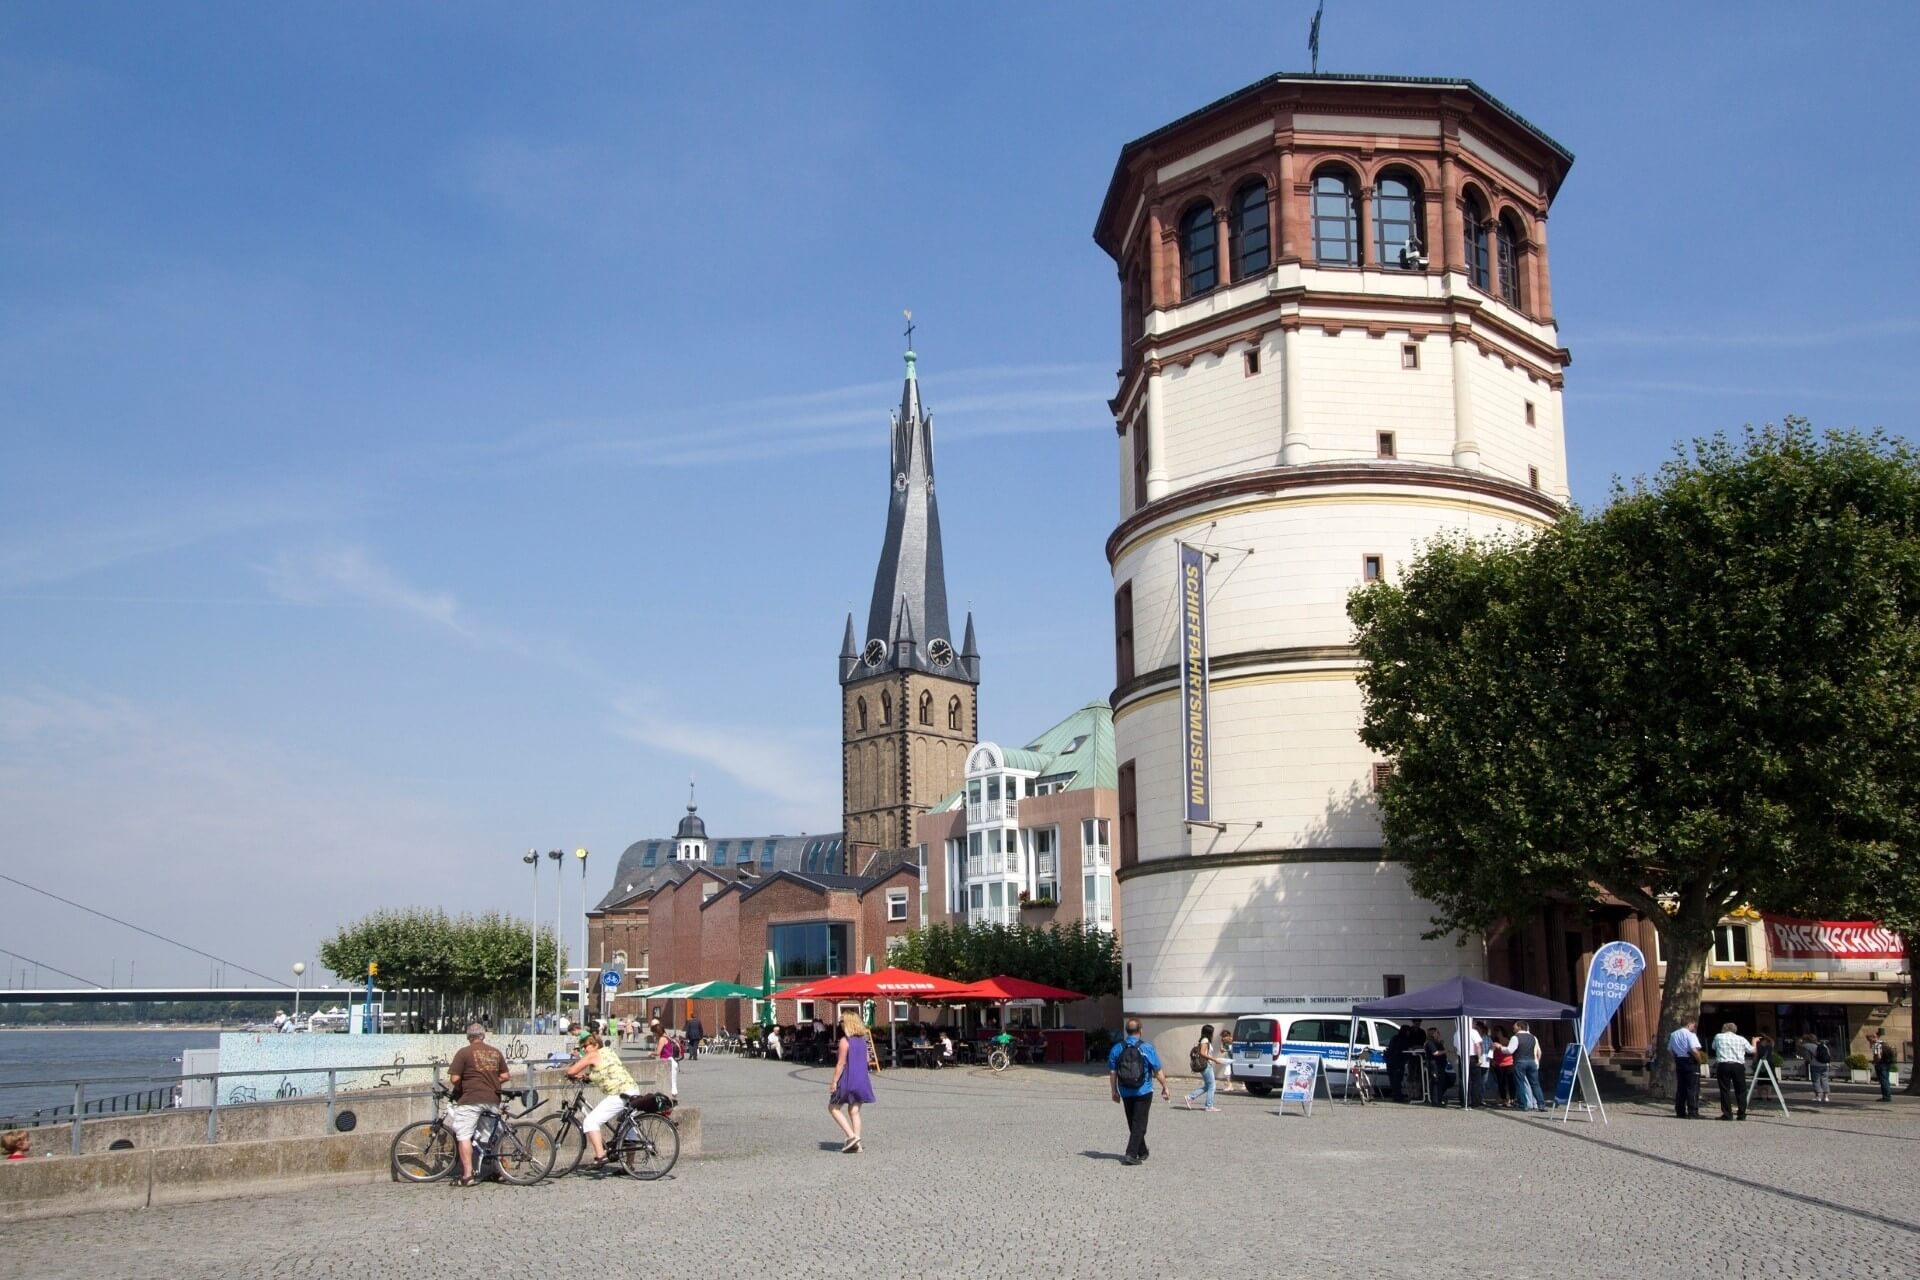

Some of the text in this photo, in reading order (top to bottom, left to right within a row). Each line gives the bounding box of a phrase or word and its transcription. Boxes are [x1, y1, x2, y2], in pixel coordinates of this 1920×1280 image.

[1186, 563, 1204, 805] SCHIFFFAHRTSMUSEUM
[1591, 979, 1628, 991] Ihr OSD
[1590, 989, 1624, 999] vor Ort
